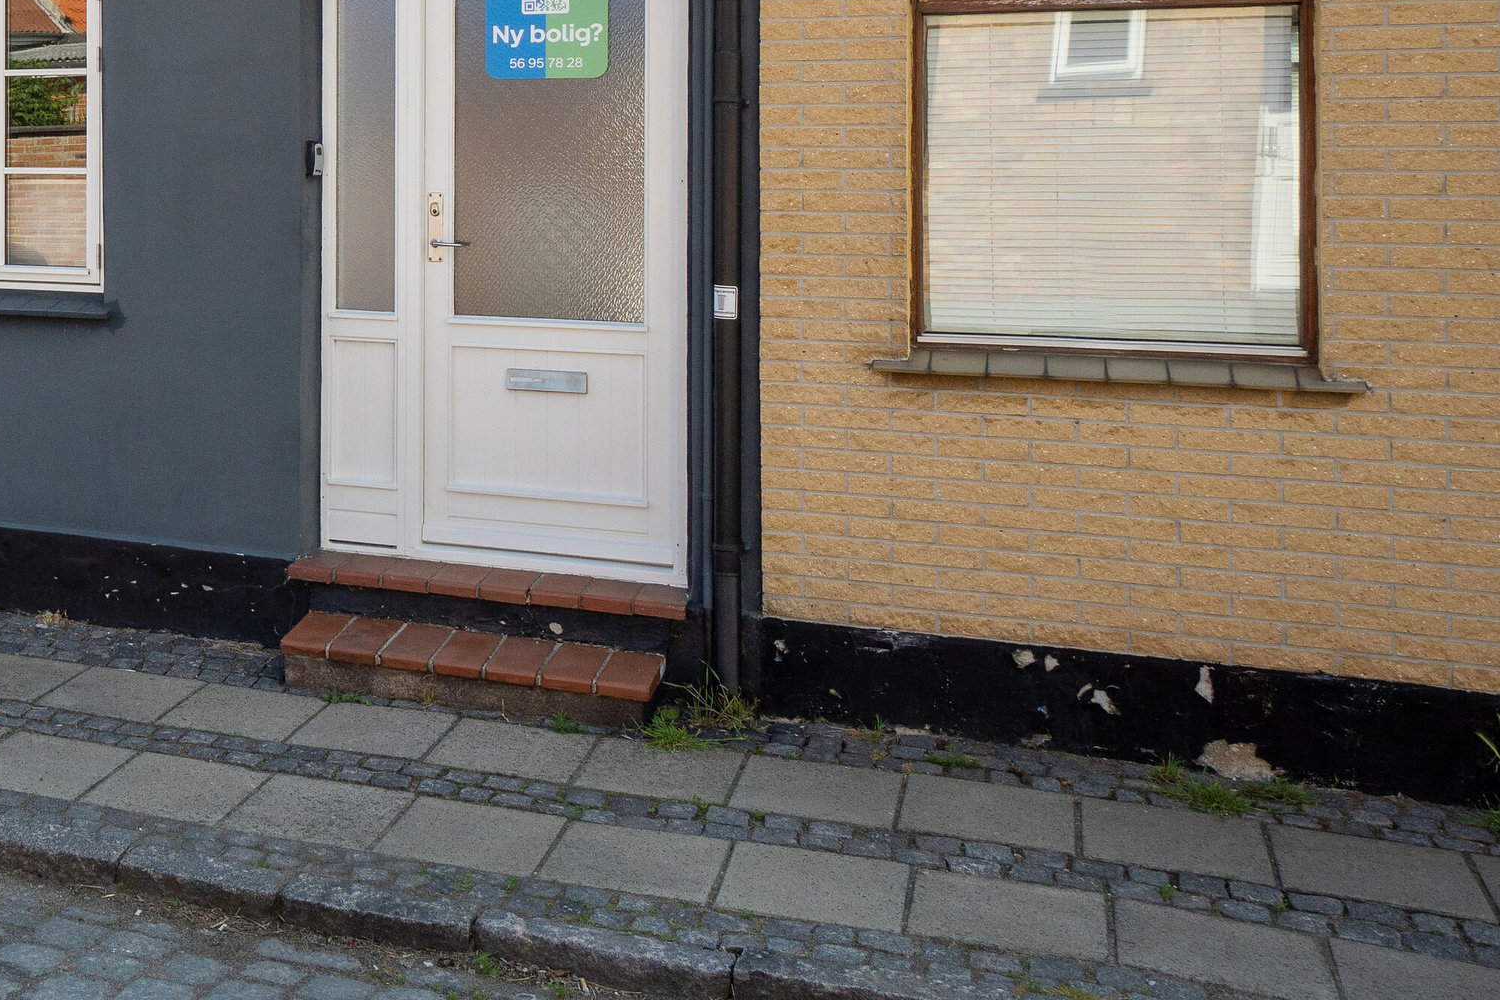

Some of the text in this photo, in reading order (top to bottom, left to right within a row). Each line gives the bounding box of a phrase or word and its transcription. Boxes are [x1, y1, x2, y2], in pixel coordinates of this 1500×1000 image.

[492, 23, 603, 48] Ny bolig?
[509, 56, 583, 69] 56 95 78 28
